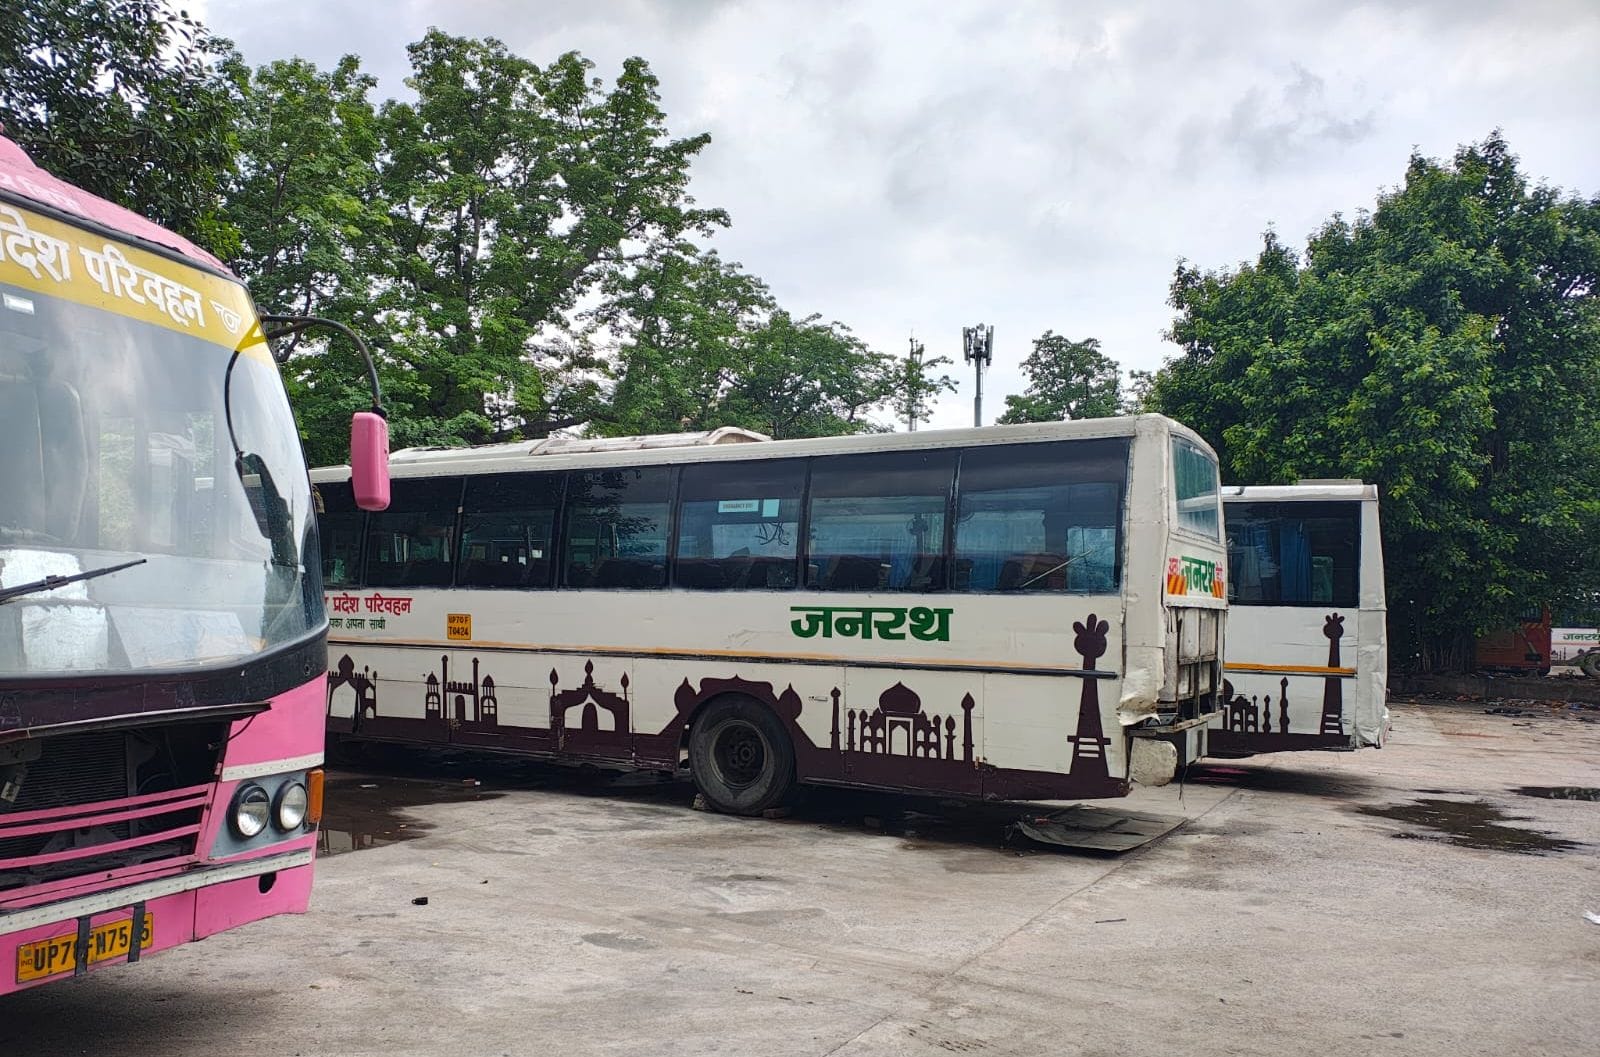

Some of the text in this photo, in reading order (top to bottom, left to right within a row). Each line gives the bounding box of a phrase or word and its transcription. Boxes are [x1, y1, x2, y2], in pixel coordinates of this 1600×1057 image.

[0, 206, 206, 328] देश परिवहन
[1181, 555, 1216, 593] जनरथ
[332, 592, 360, 614] प्रदेश
[364, 592, 413, 616] परिवहन
[329, 616, 386, 630] पका अपना साथी
[790, 606, 953, 642] जनरथ
[34, 919, 150, 972] UP7FN755
